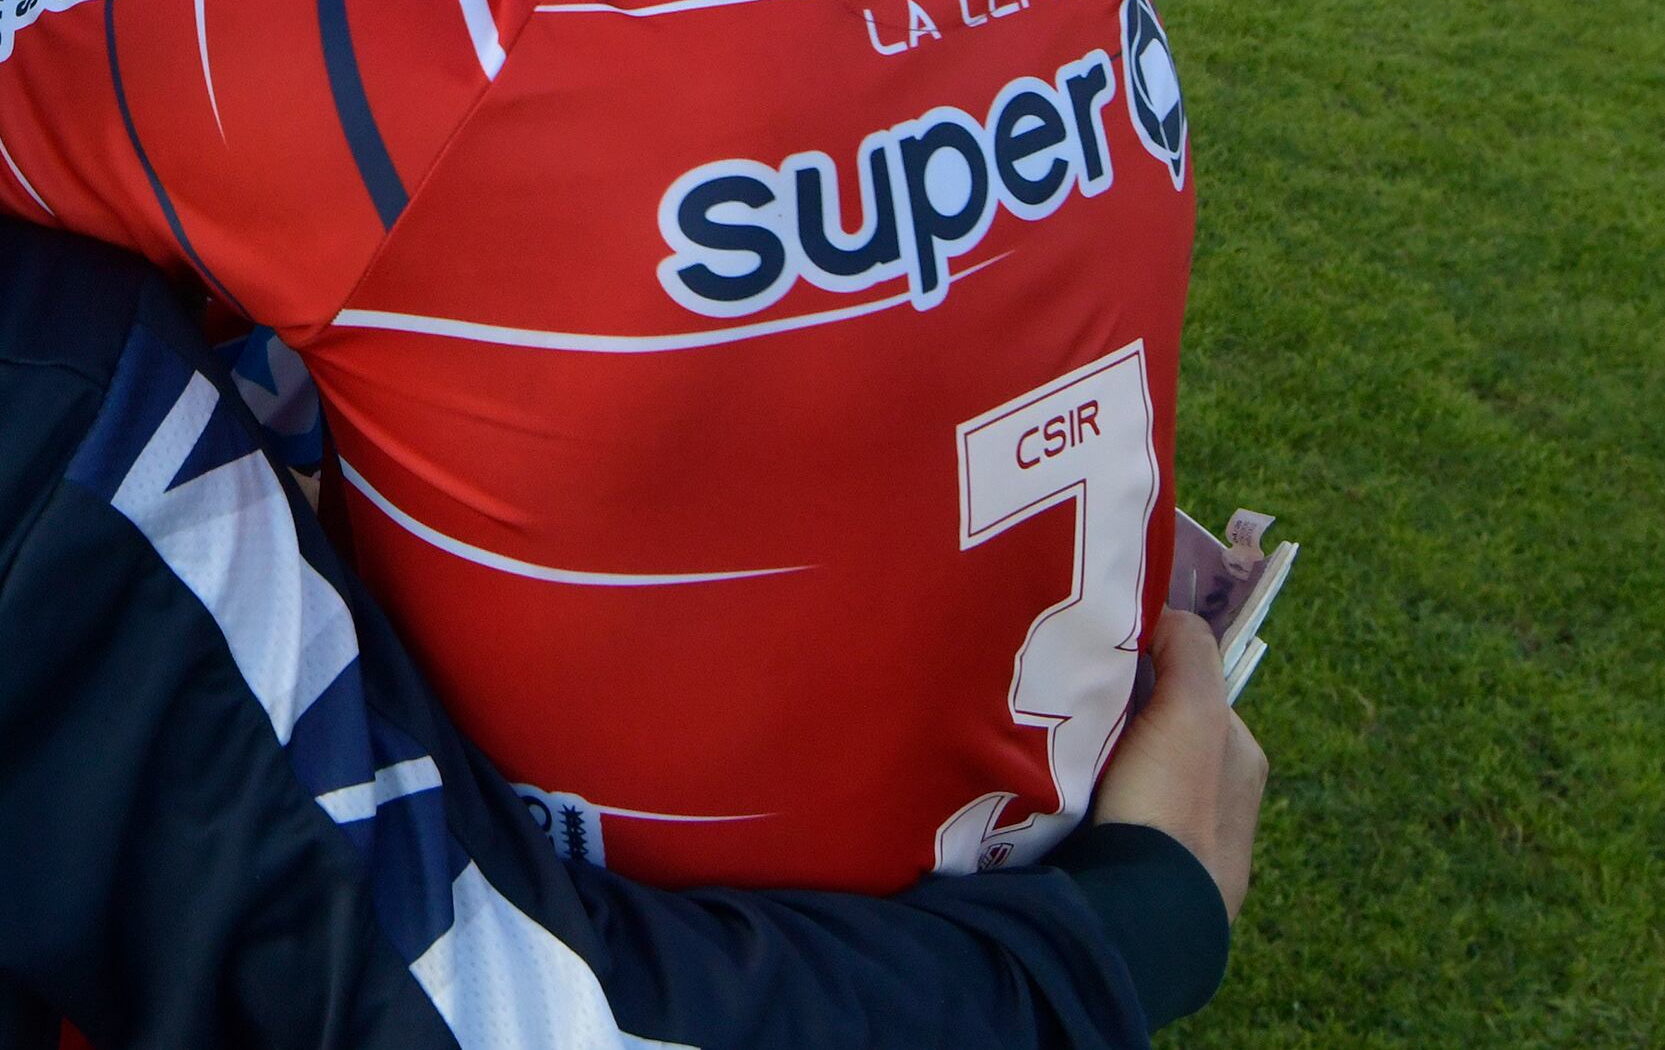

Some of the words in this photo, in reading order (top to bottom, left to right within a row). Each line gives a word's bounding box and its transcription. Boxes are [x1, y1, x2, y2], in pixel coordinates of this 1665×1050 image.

[671, 58, 1111, 306] super
[1016, 398, 1102, 470] CSIR
[936, 336, 1160, 874] 7
